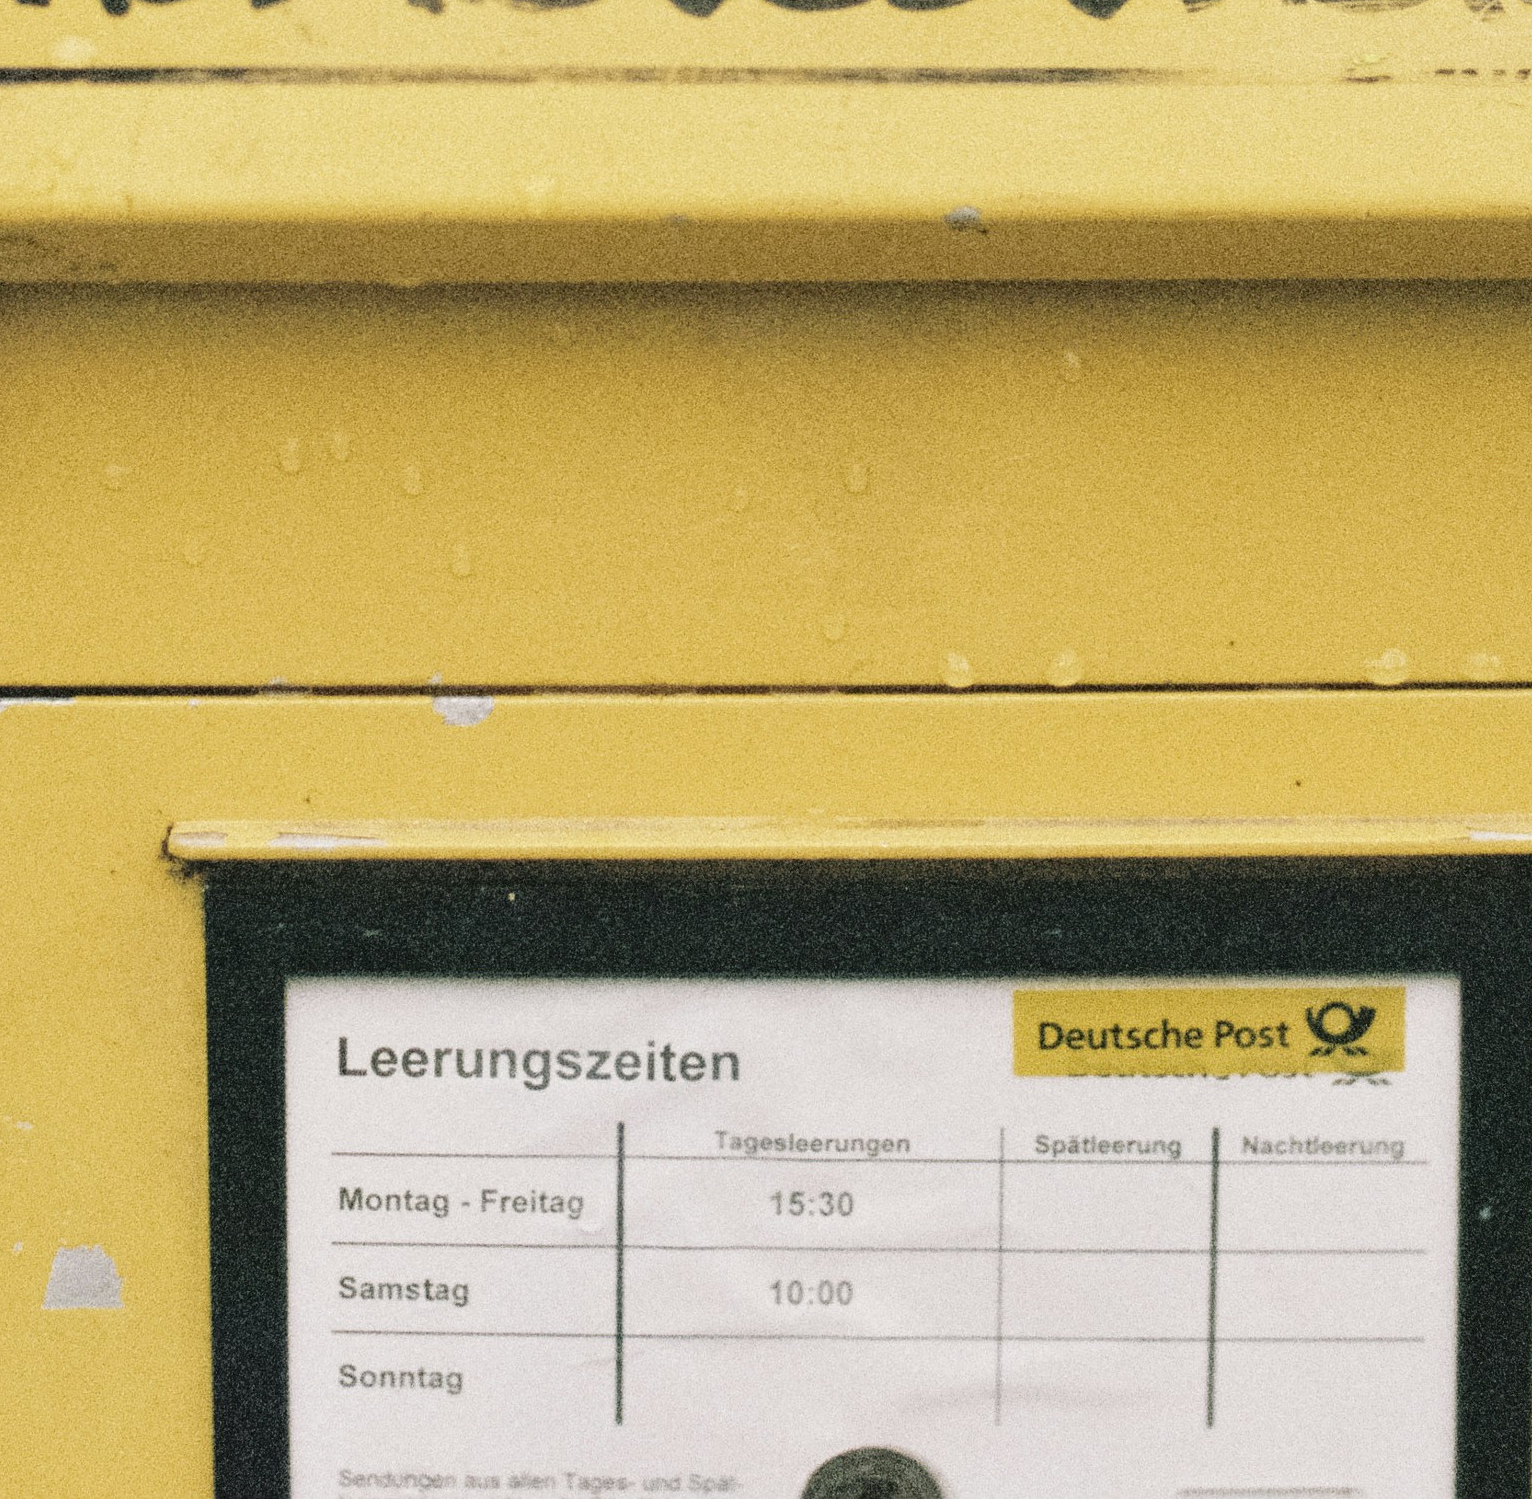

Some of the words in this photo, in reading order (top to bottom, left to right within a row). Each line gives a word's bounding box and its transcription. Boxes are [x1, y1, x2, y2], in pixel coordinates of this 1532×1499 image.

[1038, 1019, 1203, 1051] Deutsche
[1214, 1020, 1290, 1050] Post
[336, 1036, 742, 1092] Leerungszeiten
[714, 1130, 911, 1158] Tagesleerungen
[1034, 1133, 1182, 1160] Spätleerung
[1241, 1134, 1405, 1160] Nachtleerung
[338, 1186, 450, 1218] Montag
[480, 1188, 584, 1219] Freitag
[769, 1191, 855, 1217] 15:30
[338, 1276, 469, 1307] Samstag
[769, 1280, 854, 1306] 10:00
[338, 1363, 464, 1396] Sonntag
[338, 1468, 457, 1491] Sendungen
[465, 1474, 500, 1489] aus
[642, 1472, 682, 1491] und
